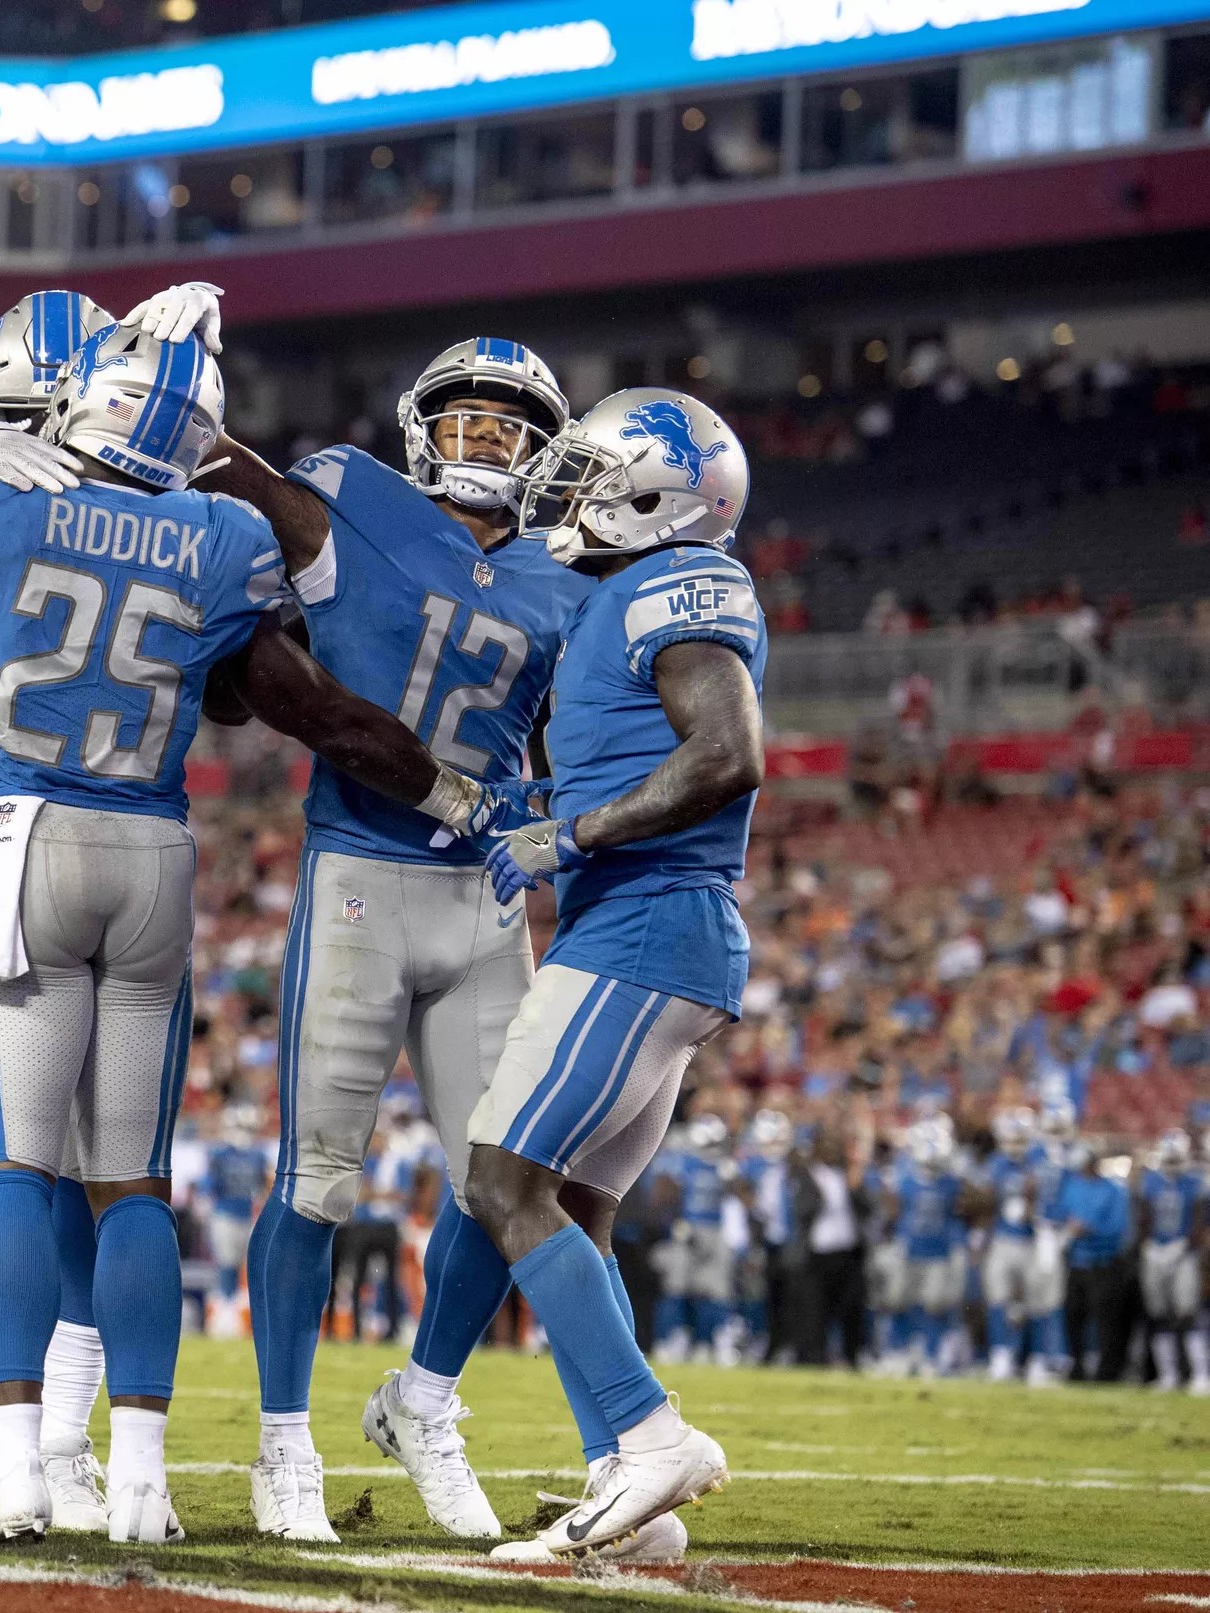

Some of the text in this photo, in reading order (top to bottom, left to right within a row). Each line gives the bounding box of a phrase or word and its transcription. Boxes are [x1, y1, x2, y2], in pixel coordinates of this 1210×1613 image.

[97, 445, 175, 485] DETROIT
[45, 496, 207, 581] RIDDICK
[666, 588, 730, 616] WCF
[397, 589, 531, 778] 12
